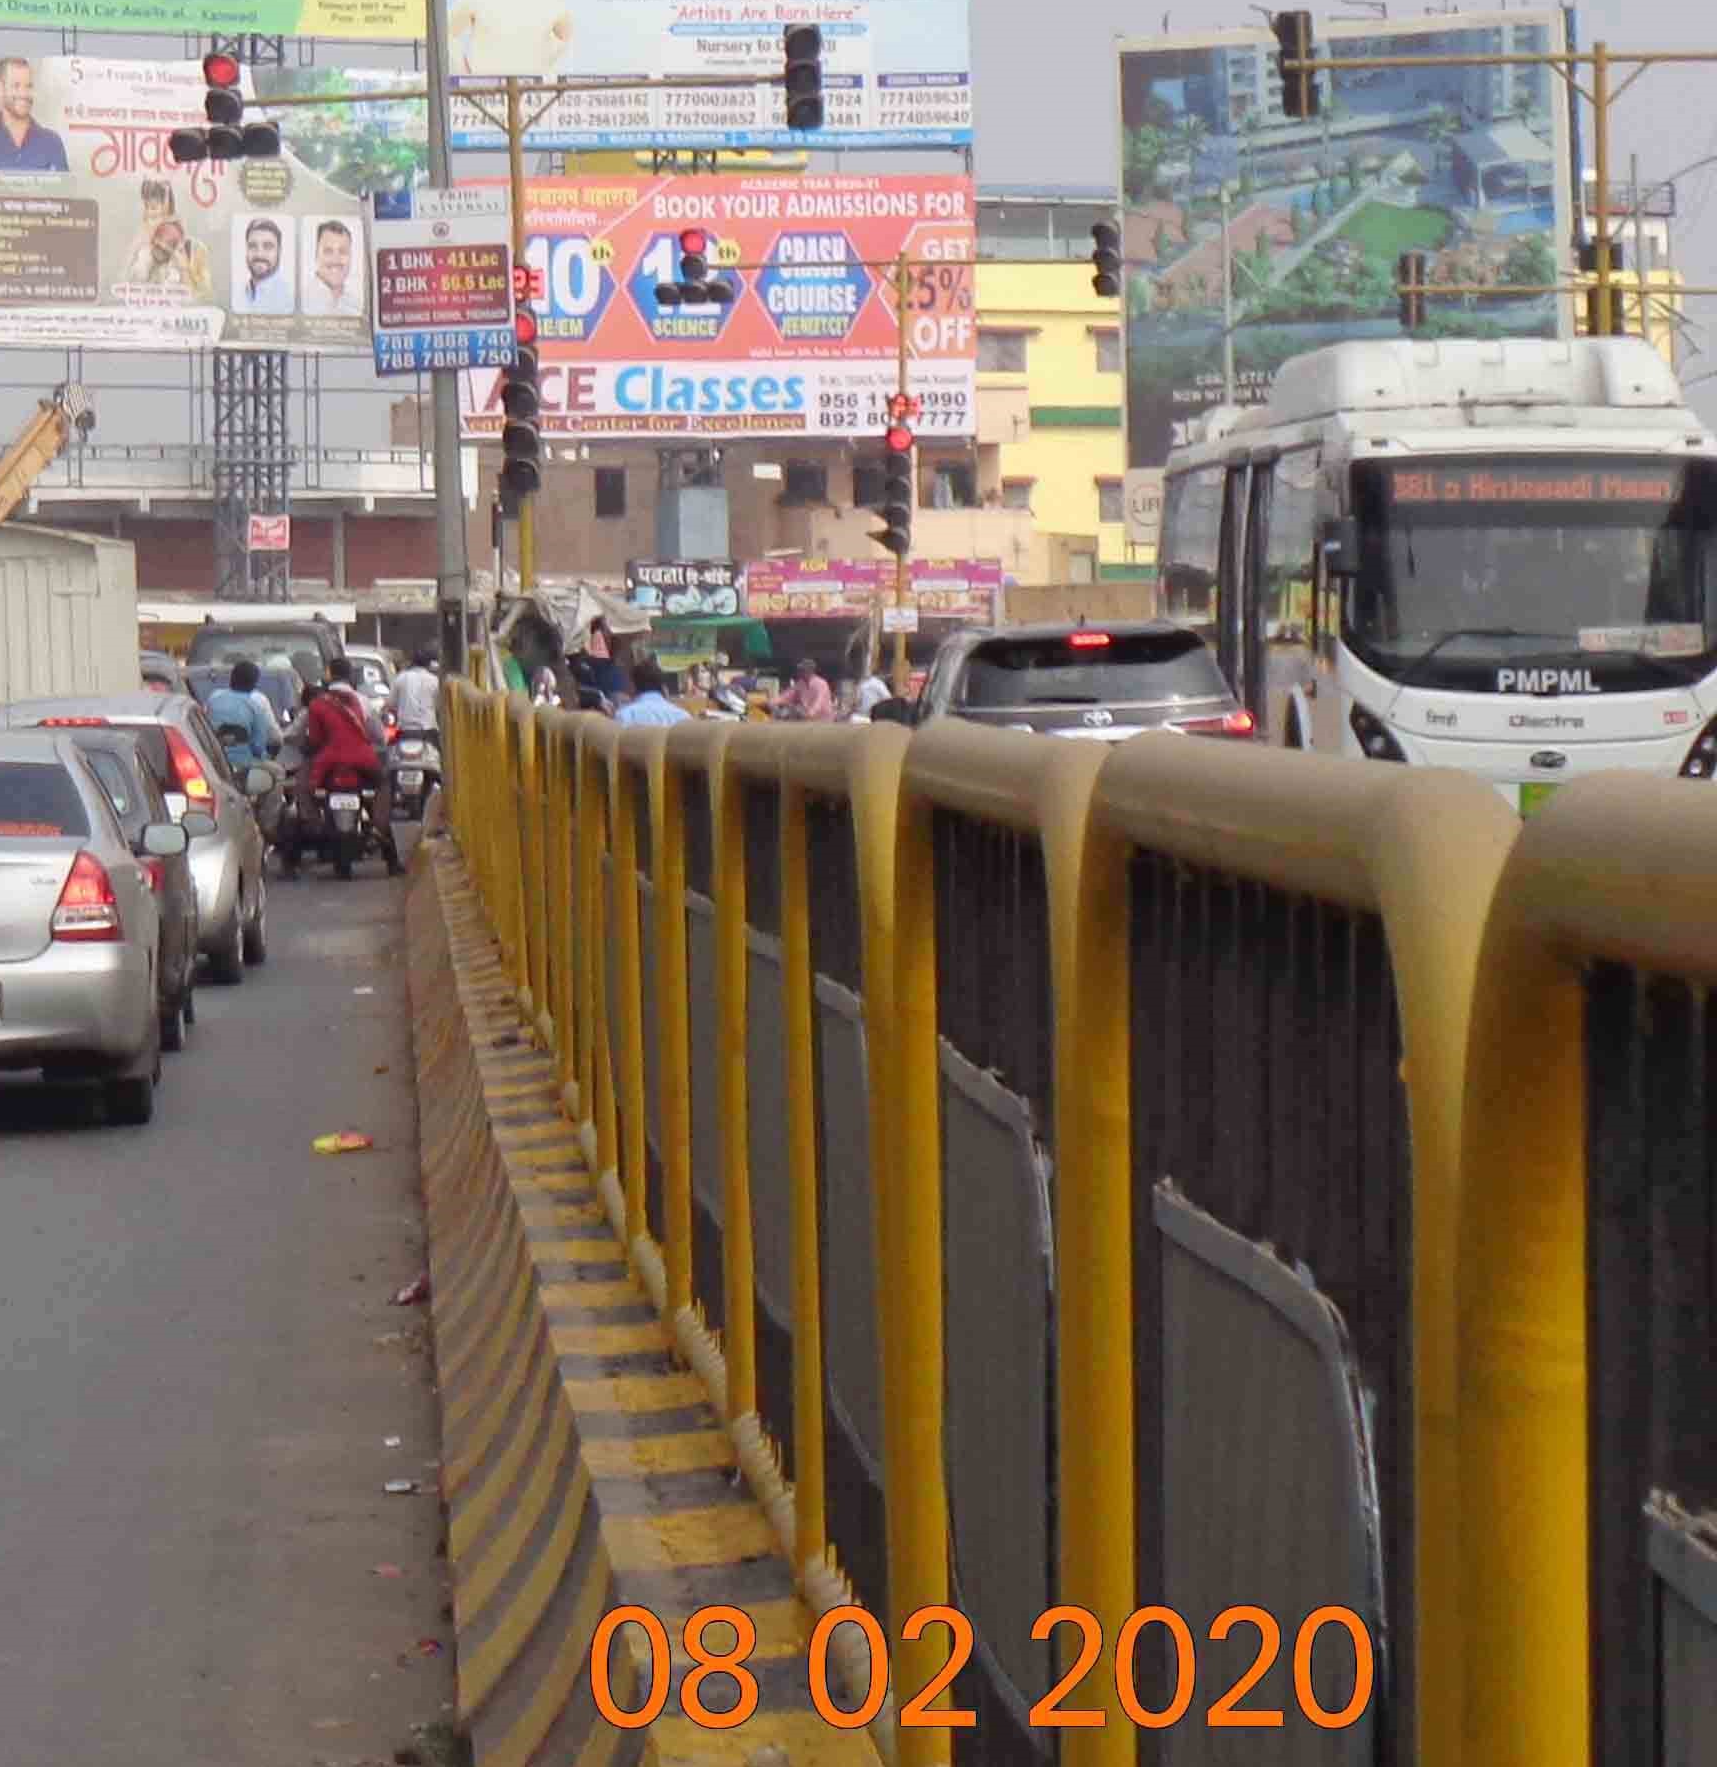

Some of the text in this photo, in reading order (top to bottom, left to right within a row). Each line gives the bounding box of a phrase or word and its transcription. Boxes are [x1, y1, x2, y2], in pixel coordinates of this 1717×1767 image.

[741, 5, 767, 21] Are
[775, 5, 809, 21] Born
[696, 38, 753, 57] Nursery
[652, 195, 716, 219] BOOK
[721, 194, 780, 219] YOUR
[786, 192, 919, 219] ADMISSIONS
[924, 192, 966, 218] FOR
[921, 237, 971, 260] GET
[402, 251, 437, 270] BHK
[395, 276, 429, 294] BHK
[767, 283, 857, 314] COURSE
[913, 316, 972, 352] OFF
[614, 365, 806, 415] Classes
[566, 413, 643, 431] Center
[648, 413, 683, 431] for
[1497, 668, 1601, 693] PMPML
